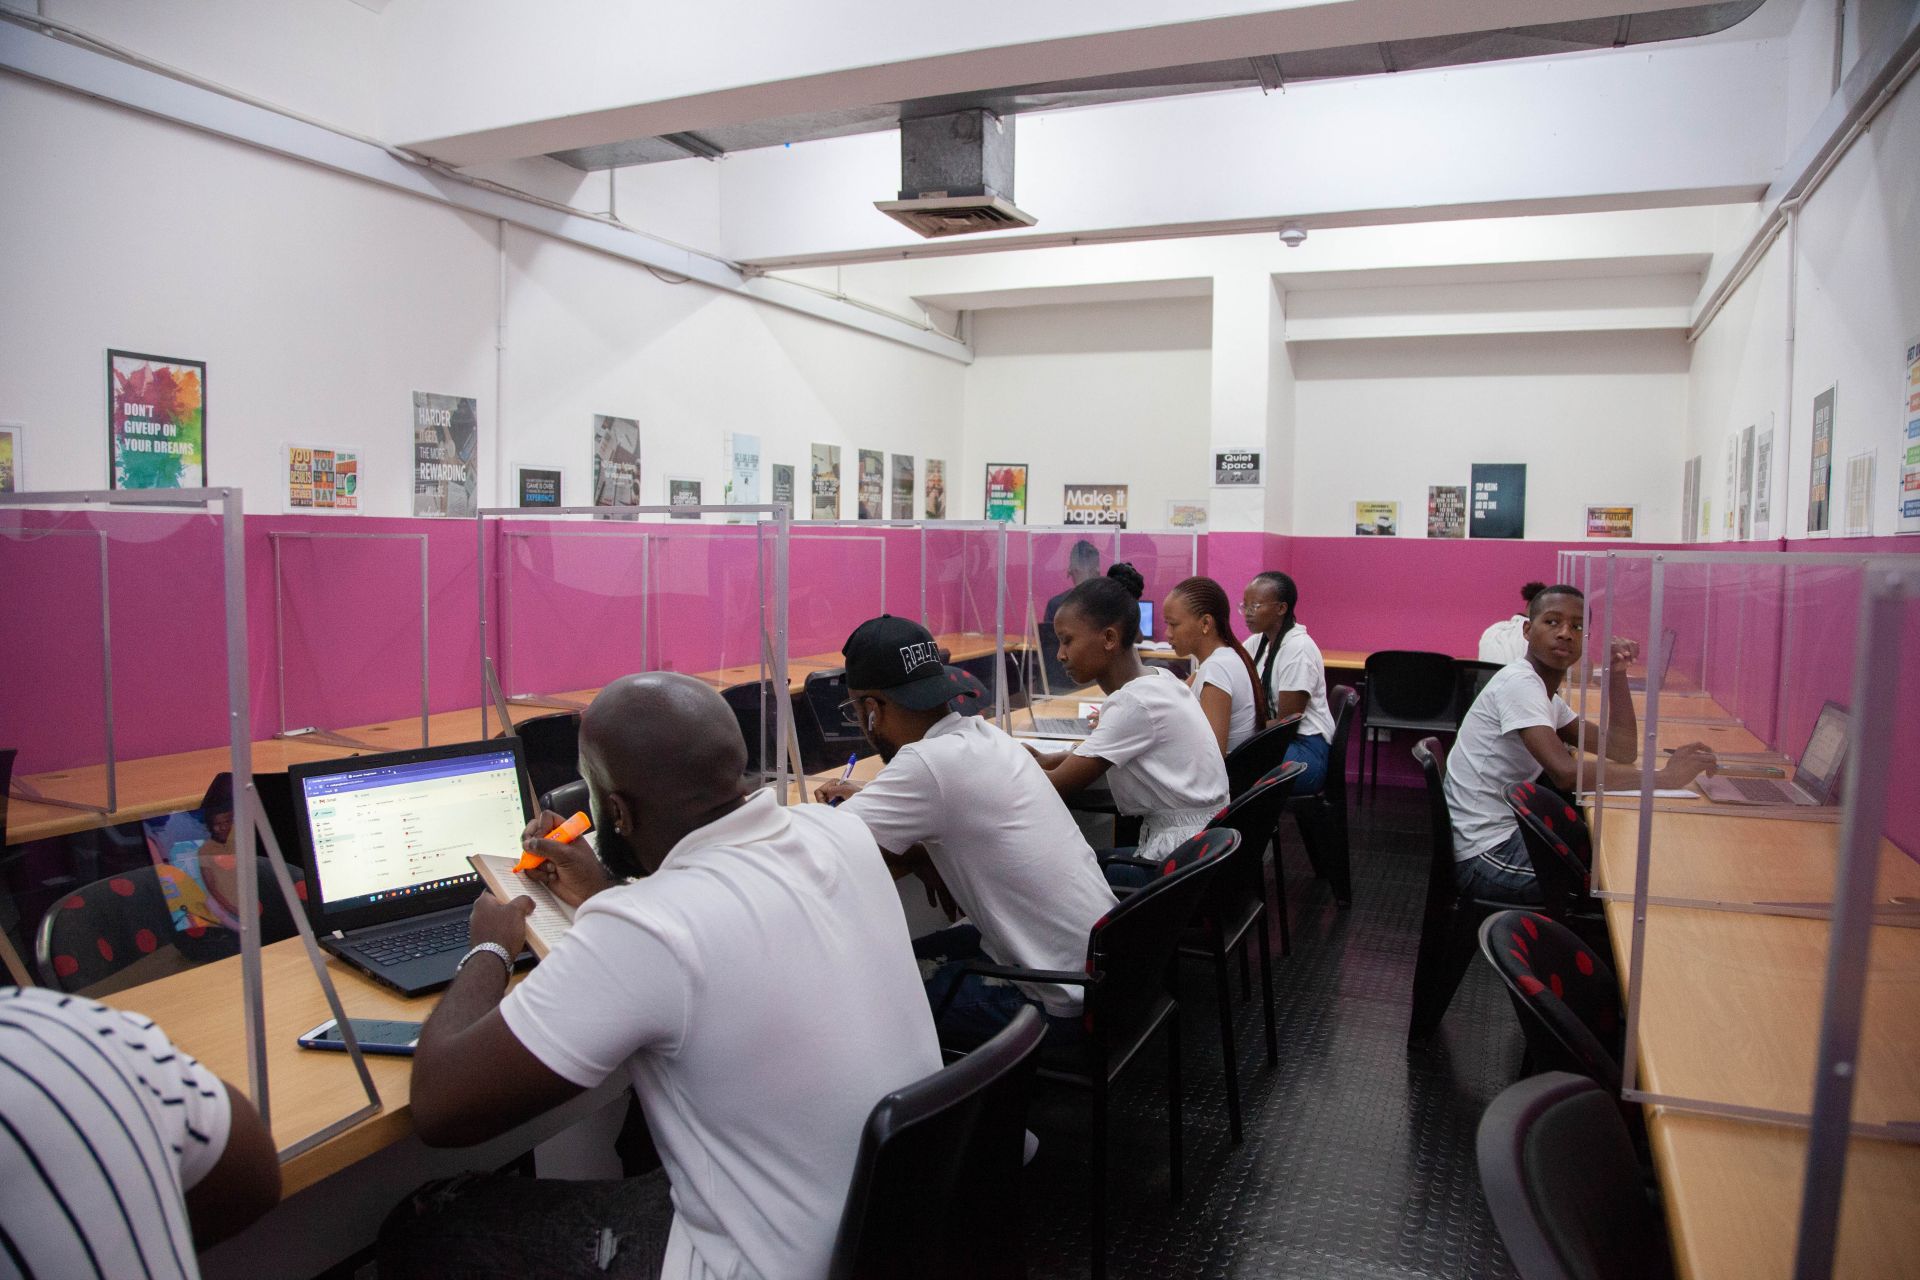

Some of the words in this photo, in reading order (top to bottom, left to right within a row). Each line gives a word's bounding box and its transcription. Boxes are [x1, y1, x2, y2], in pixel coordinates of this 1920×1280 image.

[124, 402, 154, 418] DON'T
[419, 407, 451, 428] HARDER
[124, 420, 161, 436] GIVEUP
[163, 423, 177, 437] ON
[124, 438, 152, 453] YOUR
[154, 440, 194, 456] DREAMS
[420, 446, 430, 460] THE
[290, 448, 312, 464] YOU
[315, 458, 334, 470] YOU
[1224, 454, 1252, 462] Quiet
[420, 462, 467, 482] REWARDING
[1221, 461, 1254, 471] Space
[315, 489, 334, 501] DAY
[1066, 489, 1114, 506] Make
[1116, 490, 1126, 506] it
[1065, 505, 1127, 525] happen
[900, 641, 940, 675] RELA
